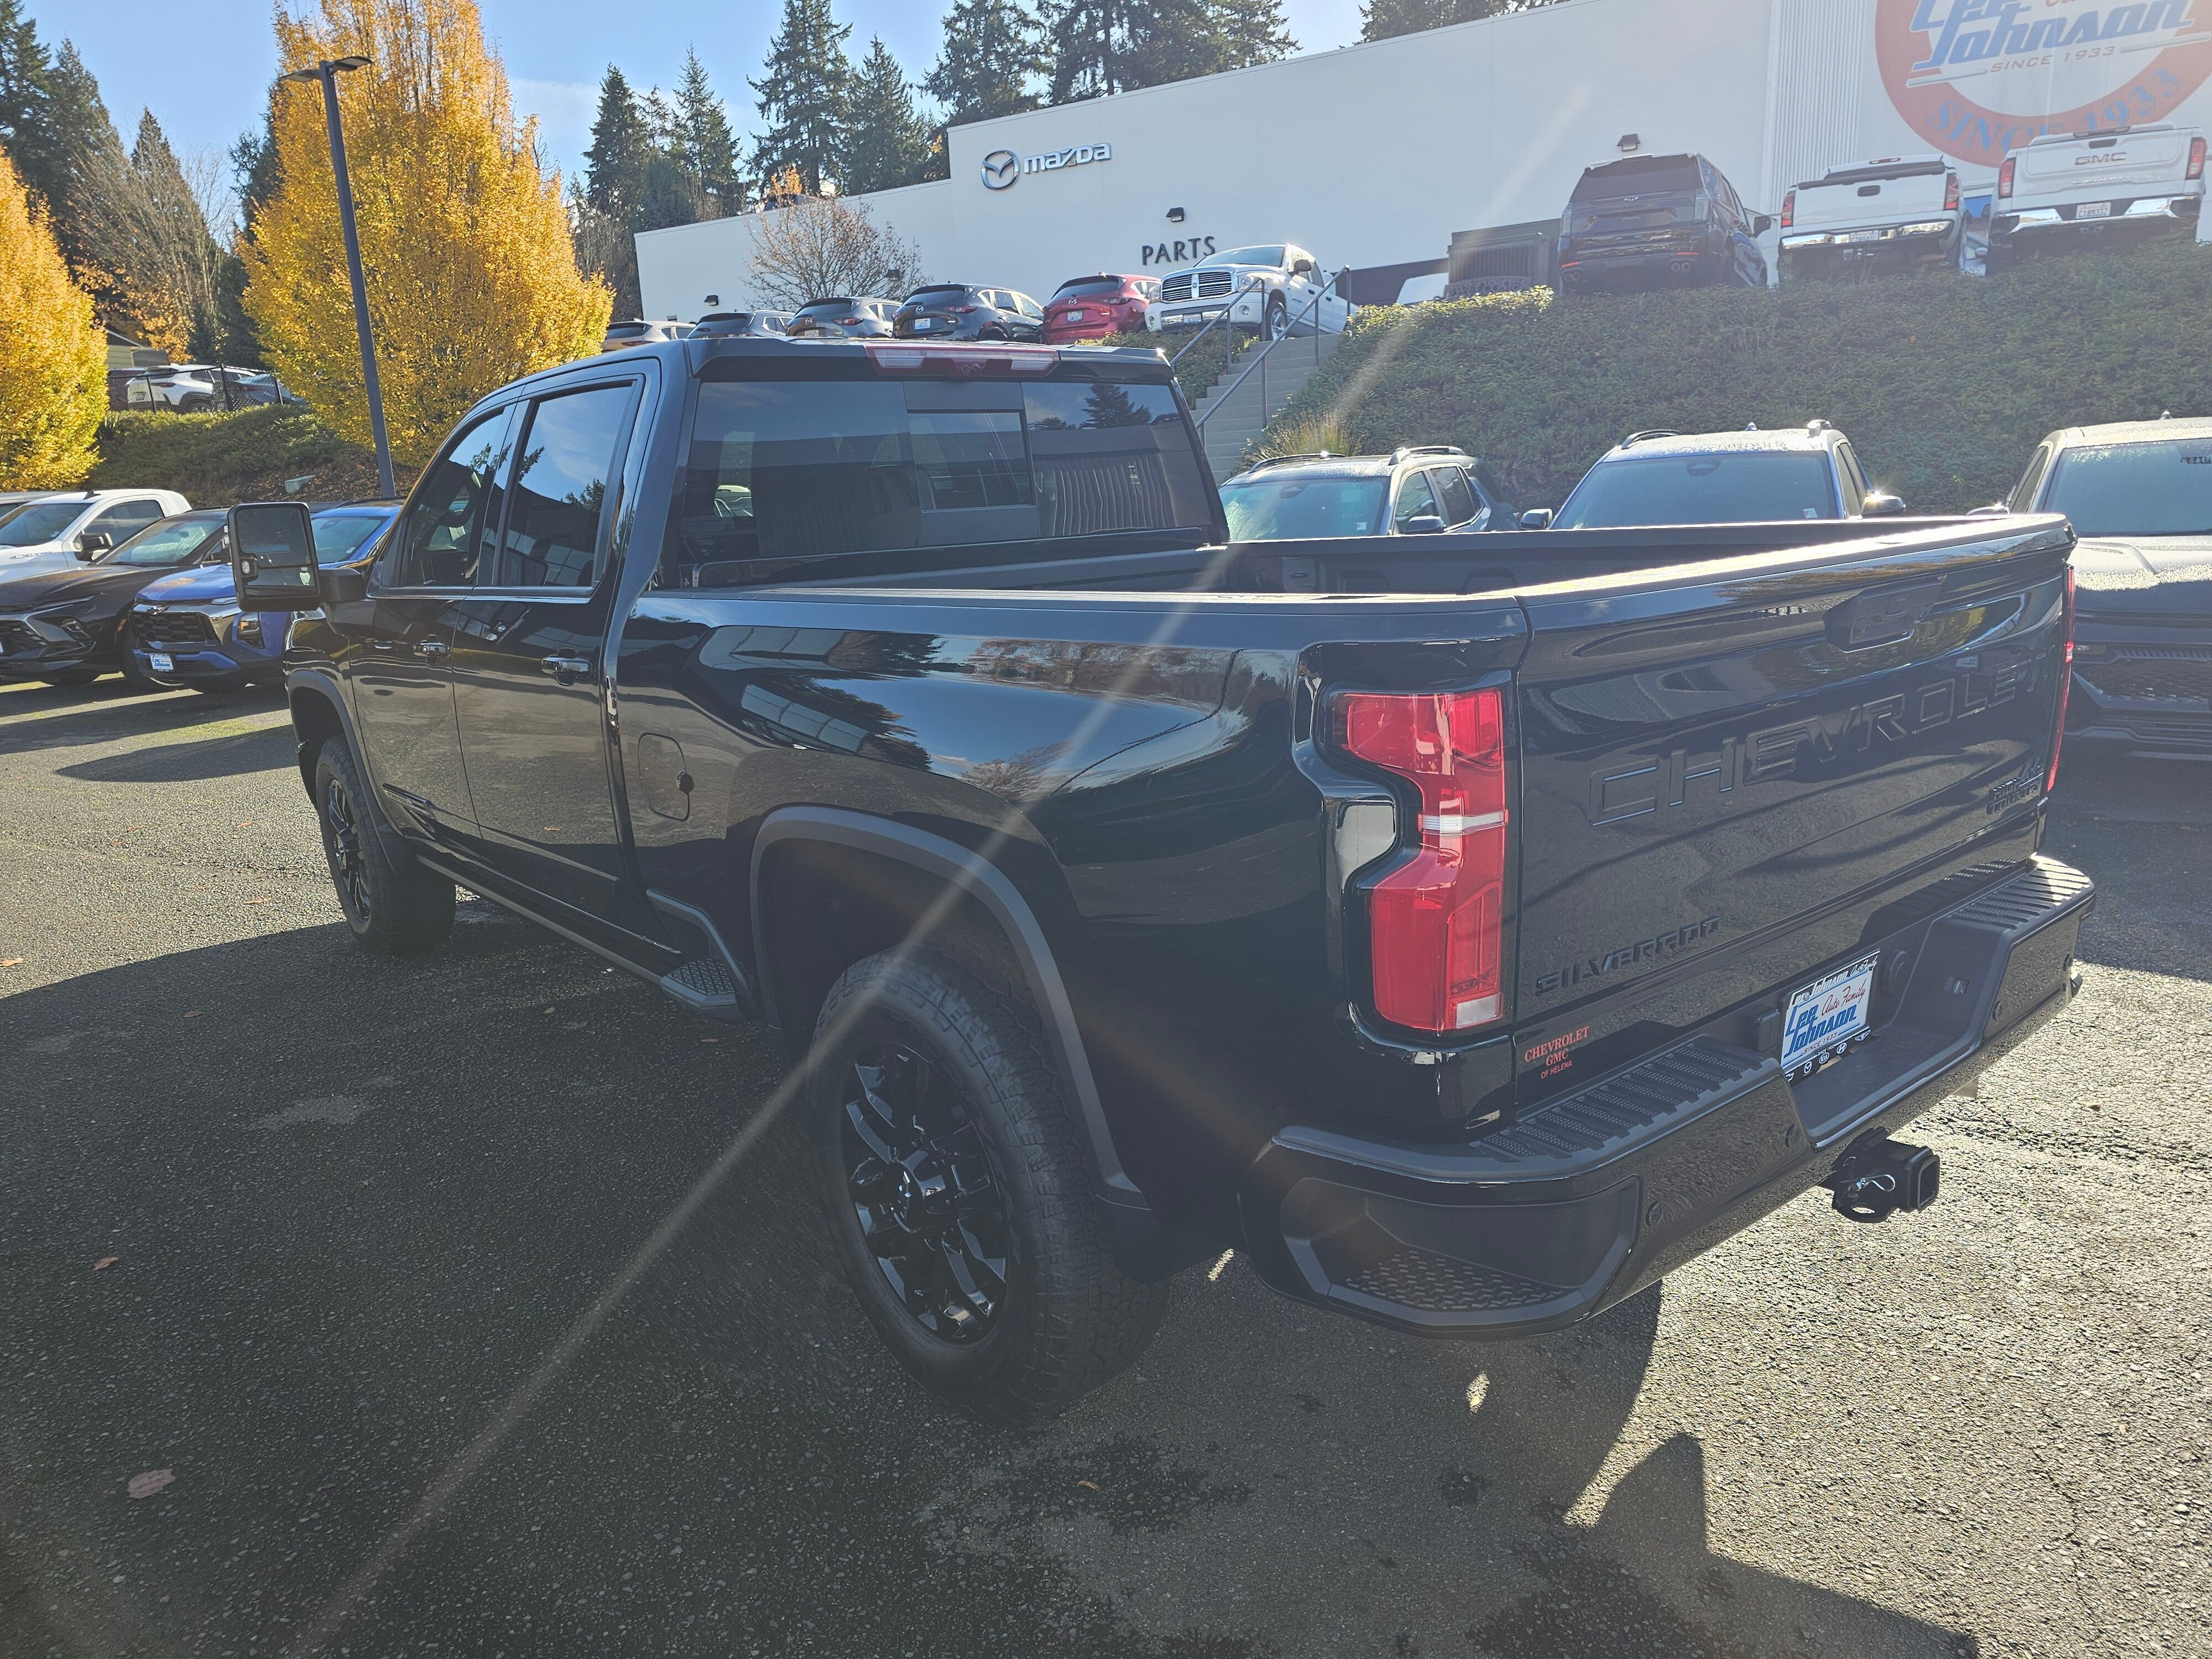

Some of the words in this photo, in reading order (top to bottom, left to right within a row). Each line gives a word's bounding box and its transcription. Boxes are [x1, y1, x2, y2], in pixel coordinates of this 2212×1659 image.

[1912, 0, 2196, 71] Johnson
[1990, 55, 2053, 72] SINCE
[2064, 46, 2116, 62] 1933
[2084, 67, 2180, 134] 1933
[1023, 142, 1111, 174] mazda
[2075, 152, 2127, 165] GMC
[1142, 236, 1215, 265] PARTS
[1589, 647, 2048, 827] CHEVROLET
[1536, 916, 1721, 996] SILVERADO
[1788, 992, 1810, 1009] Le
[1822, 994, 1840, 1016] Auto
[1841, 978, 1866, 1006] Family
[1783, 1004, 1857, 1058] Johnson
[1785, 1004, 1818, 1037] Lee
[1524, 1026, 1590, 1062] CHEVROLET
[1546, 1048, 1569, 1067] GMC
[1803, 1041, 1821, 1054] SINCE
[1823, 1032, 1837, 1044] 1933
[1541, 1070, 1550, 1079] OF
[1550, 1060, 1573, 1076] HELENA
